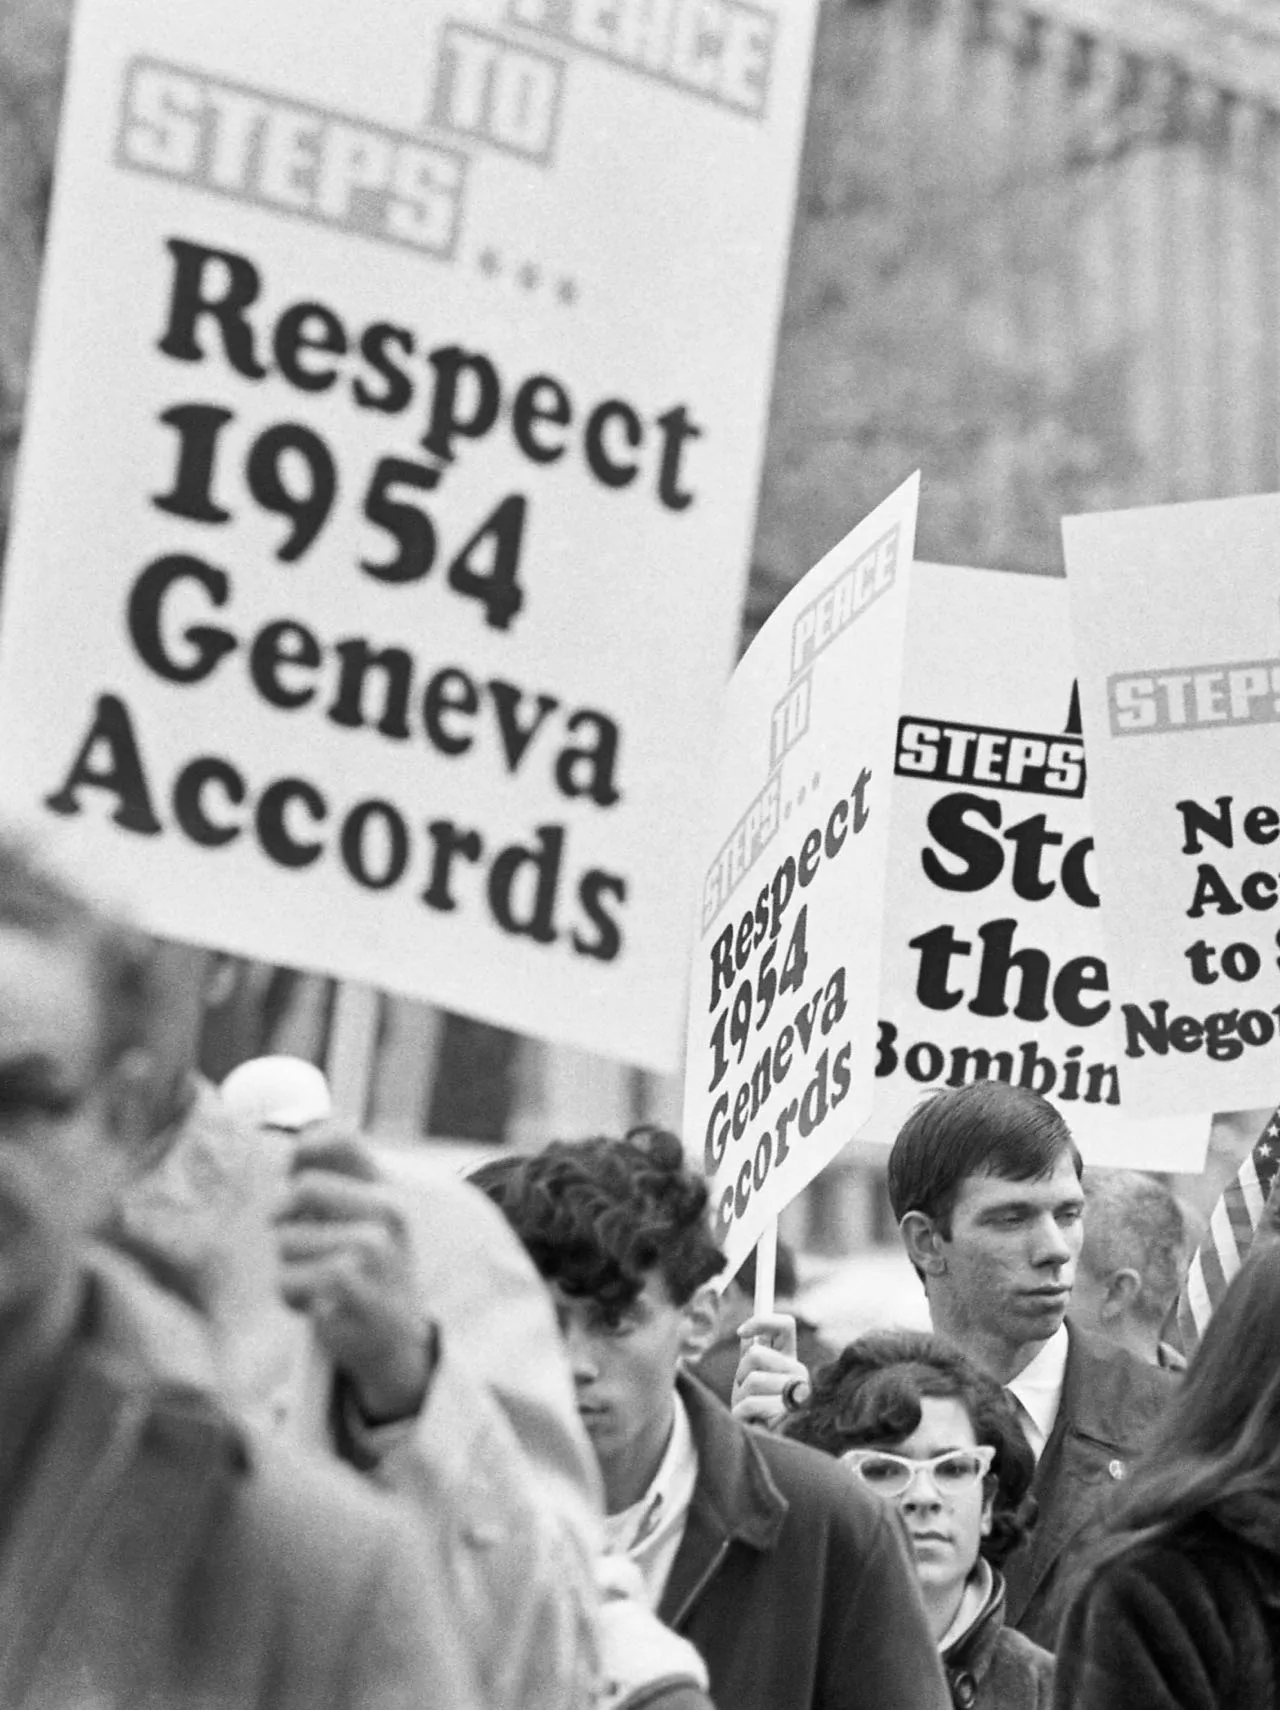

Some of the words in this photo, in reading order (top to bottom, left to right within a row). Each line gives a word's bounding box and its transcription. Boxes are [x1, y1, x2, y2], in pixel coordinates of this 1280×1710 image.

[443, 36, 556, 148] TO
[158, 237, 702, 512] Respect
[151, 403, 528, 630] 1954
[793, 530, 896, 676] PEACE
[127, 552, 620, 807] Geneva
[773, 677, 810, 765] TO
[900, 723, 1085, 791] STEPS
[44, 693, 627, 960] Accords
[708, 766, 872, 1013] Respect
[708, 903, 808, 1092] 1954
[909, 918, 1112, 1027] the
[1184, 939, 1261, 985] to
[704, 967, 847, 1177] Geneva
